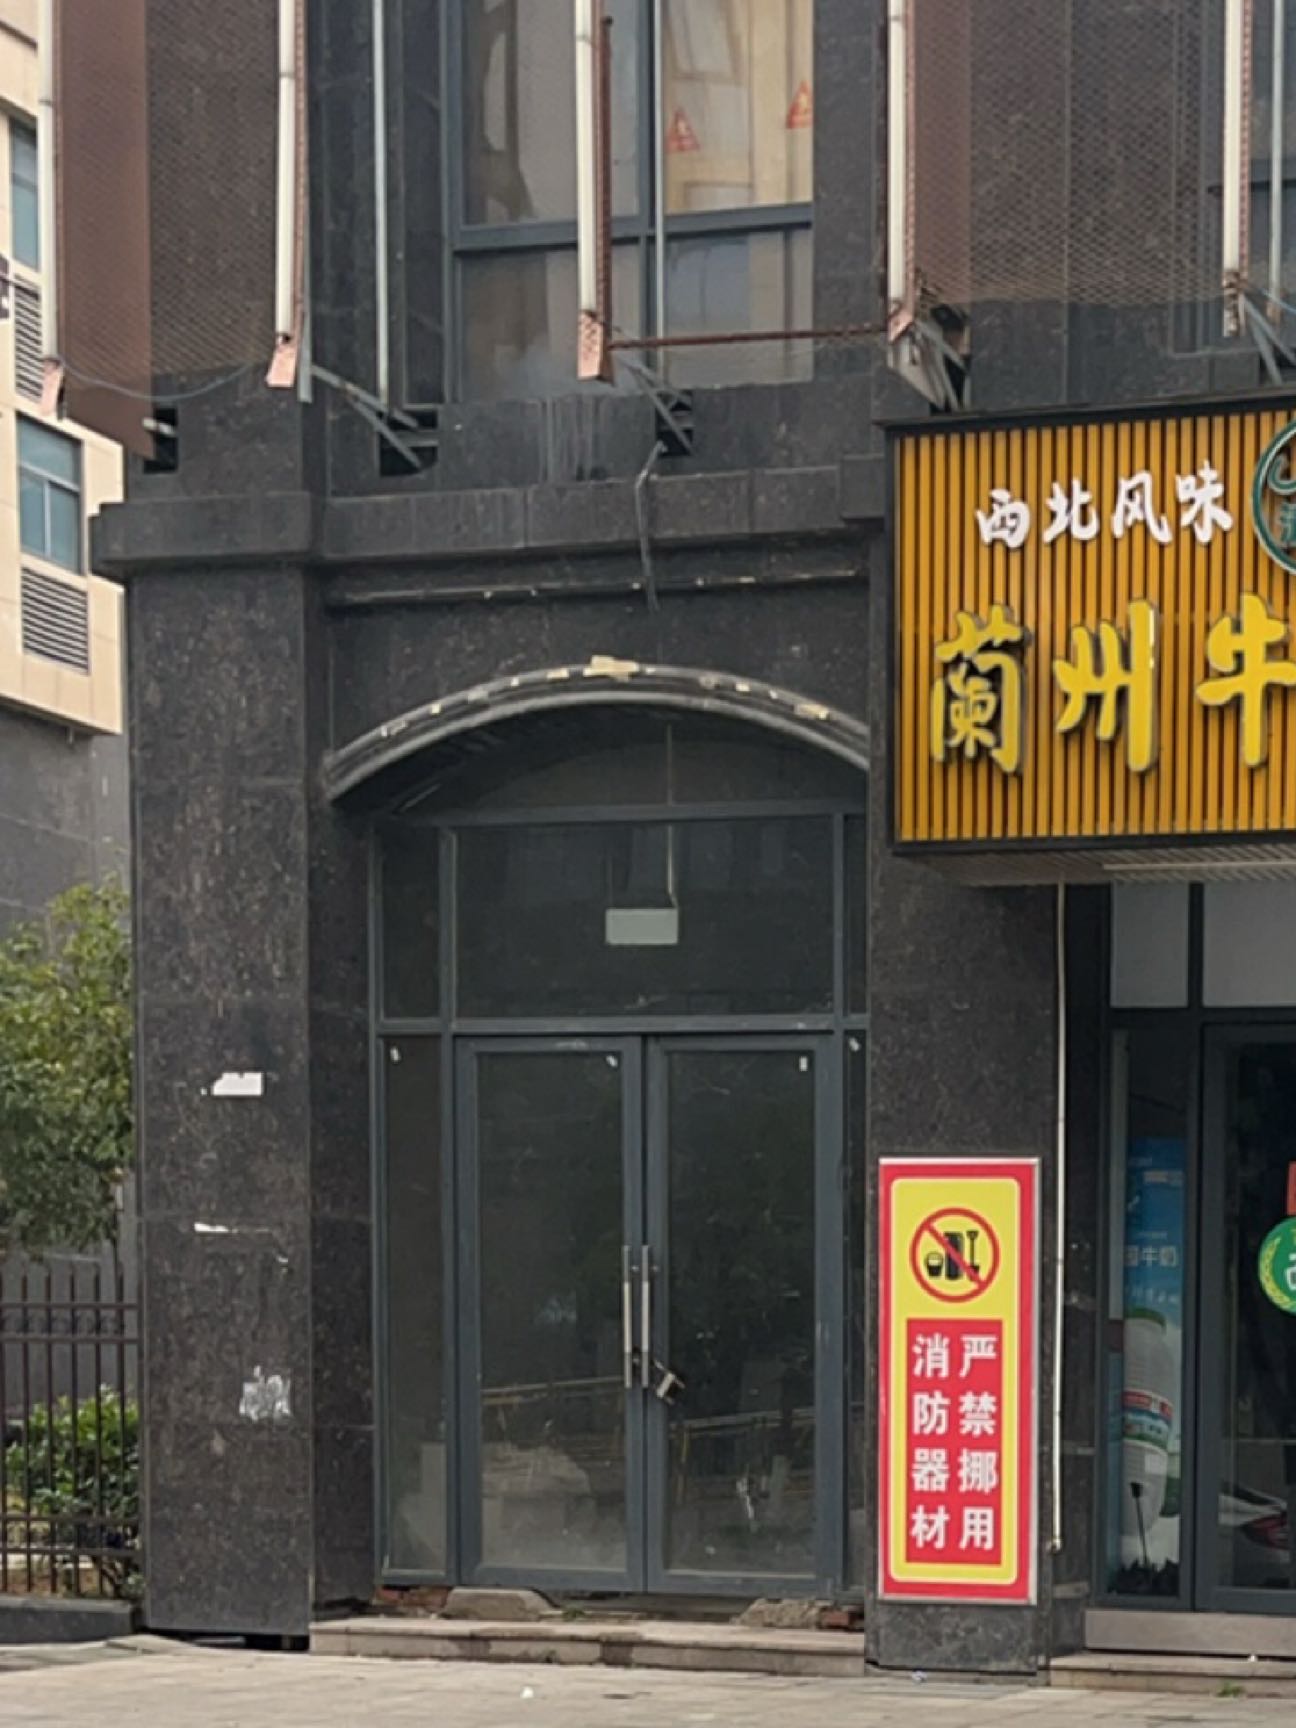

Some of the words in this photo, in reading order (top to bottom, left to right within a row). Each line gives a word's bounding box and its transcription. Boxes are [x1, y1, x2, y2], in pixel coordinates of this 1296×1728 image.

[974, 460, 1234, 547] 西北风味
[911, 1333, 951, 1550] 消防器材
[958, 1334, 998, 1550] 严禁挪用
